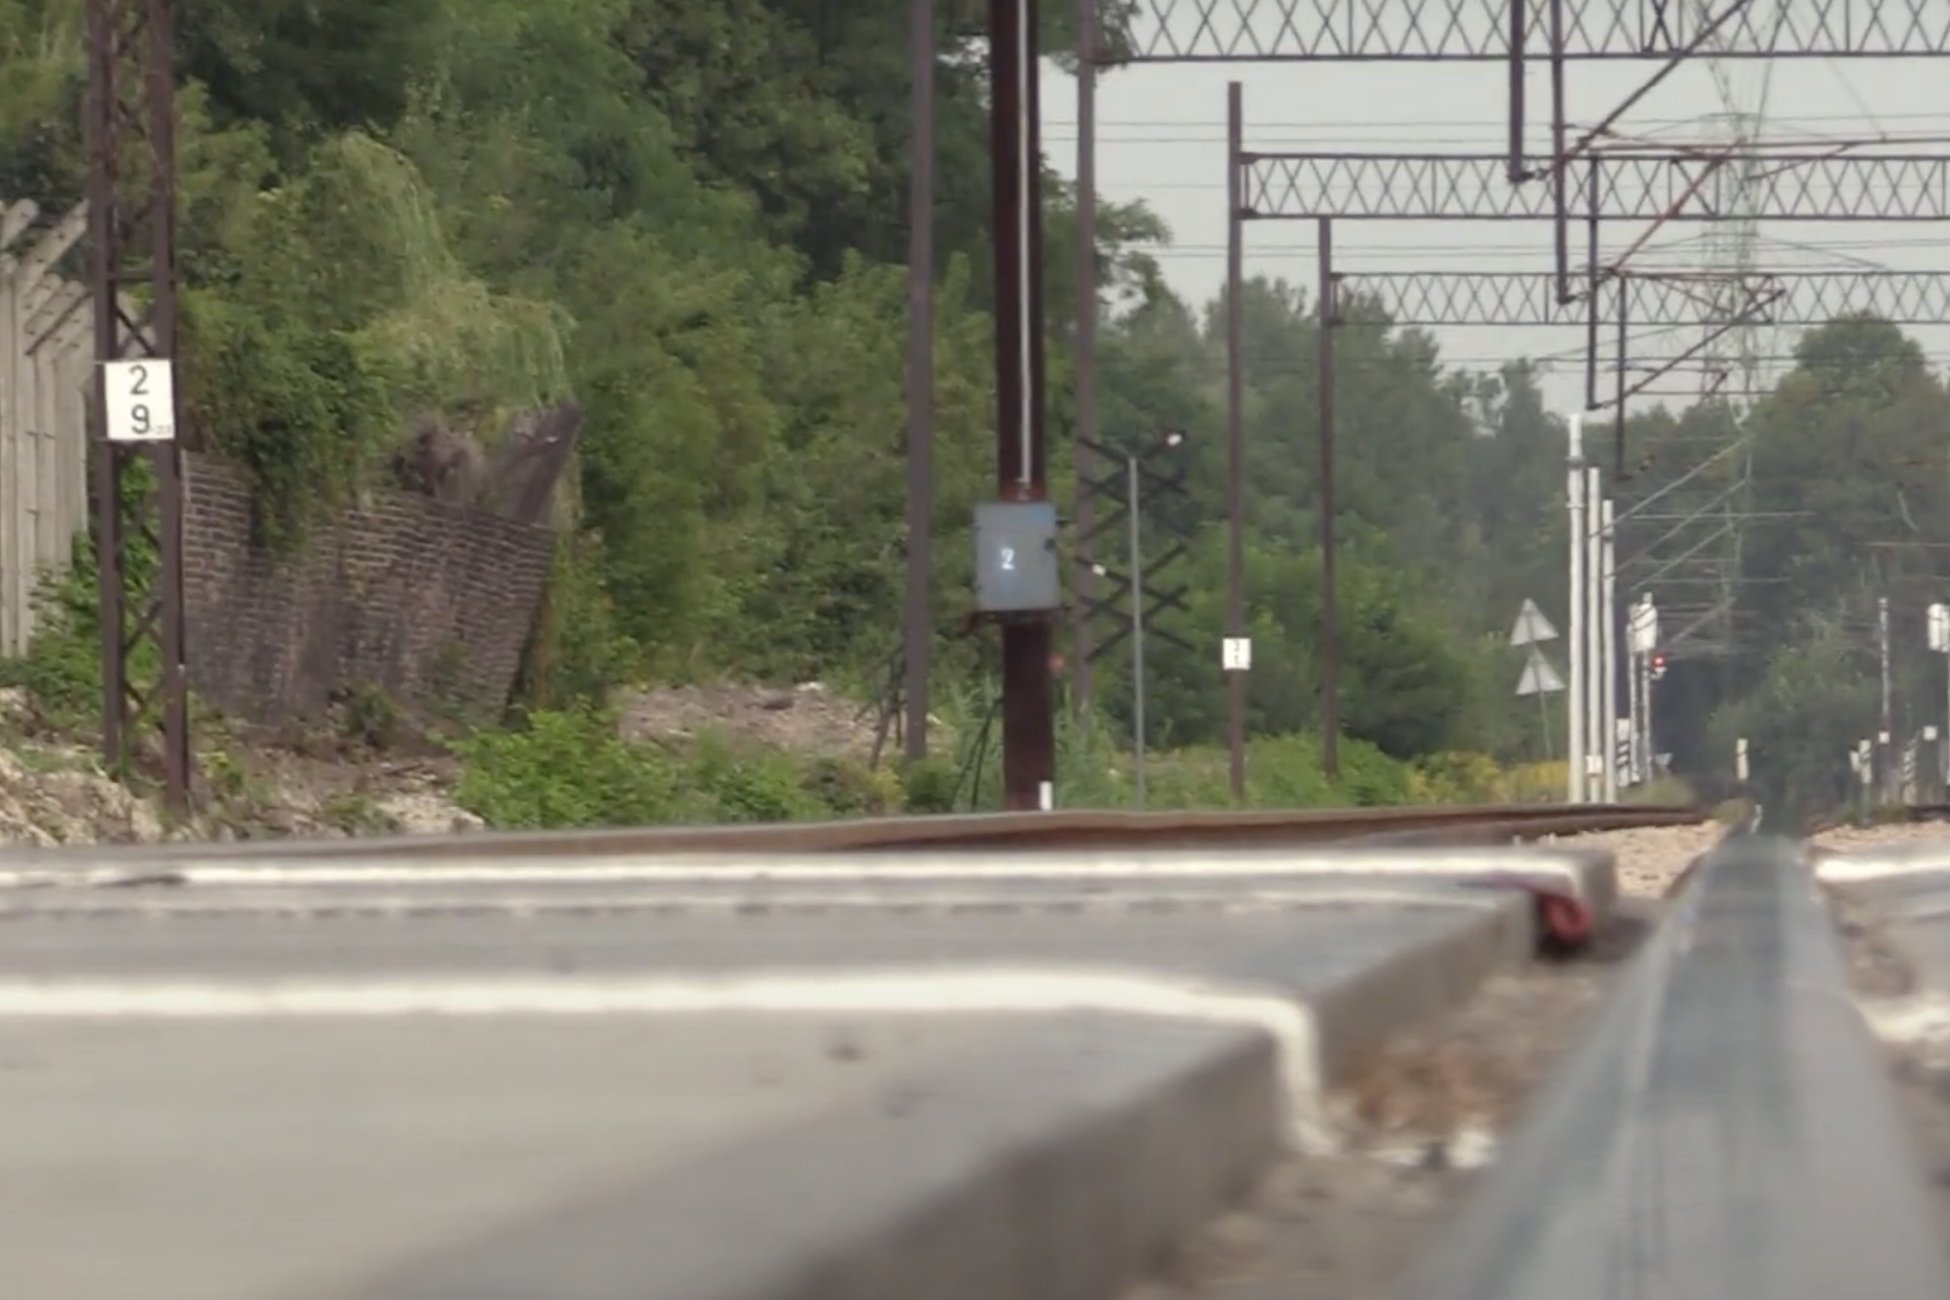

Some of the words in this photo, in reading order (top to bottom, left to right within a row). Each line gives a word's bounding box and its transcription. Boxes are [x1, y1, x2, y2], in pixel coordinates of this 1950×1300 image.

[129, 364, 149, 395] 2
[131, 403, 150, 434] 9
[1001, 547, 1015, 571] 2
